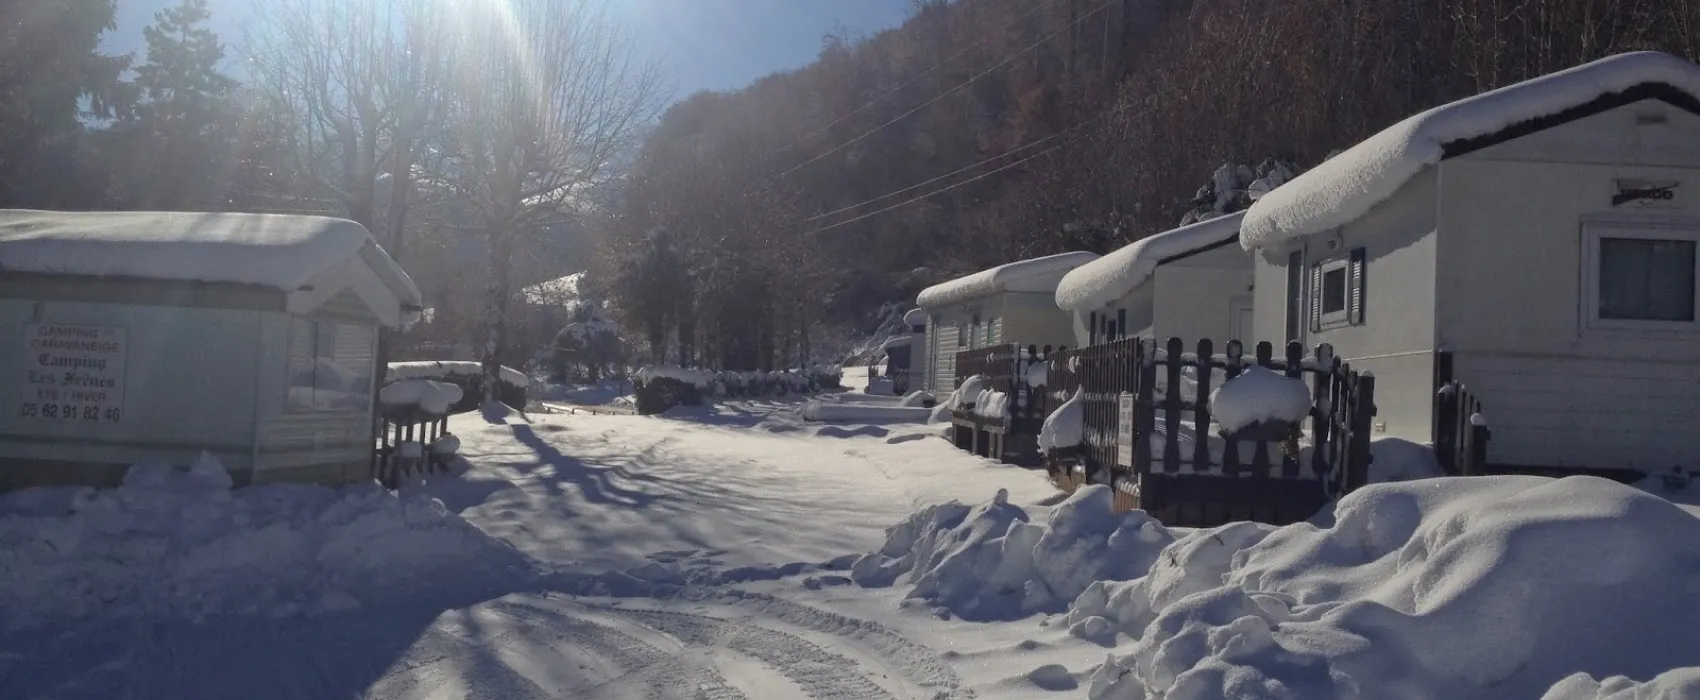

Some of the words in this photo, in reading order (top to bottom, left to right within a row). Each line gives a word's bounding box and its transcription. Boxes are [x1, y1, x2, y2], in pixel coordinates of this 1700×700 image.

[39, 326, 99, 338] CAMPING
[39, 353, 107, 371] Camping
[72, 391, 106, 402] HIVER
[21, 403, 38, 418] 05
[42, 403, 58, 418] 62
[63, 405, 77, 419] 91
[83, 406, 99, 421] 82
